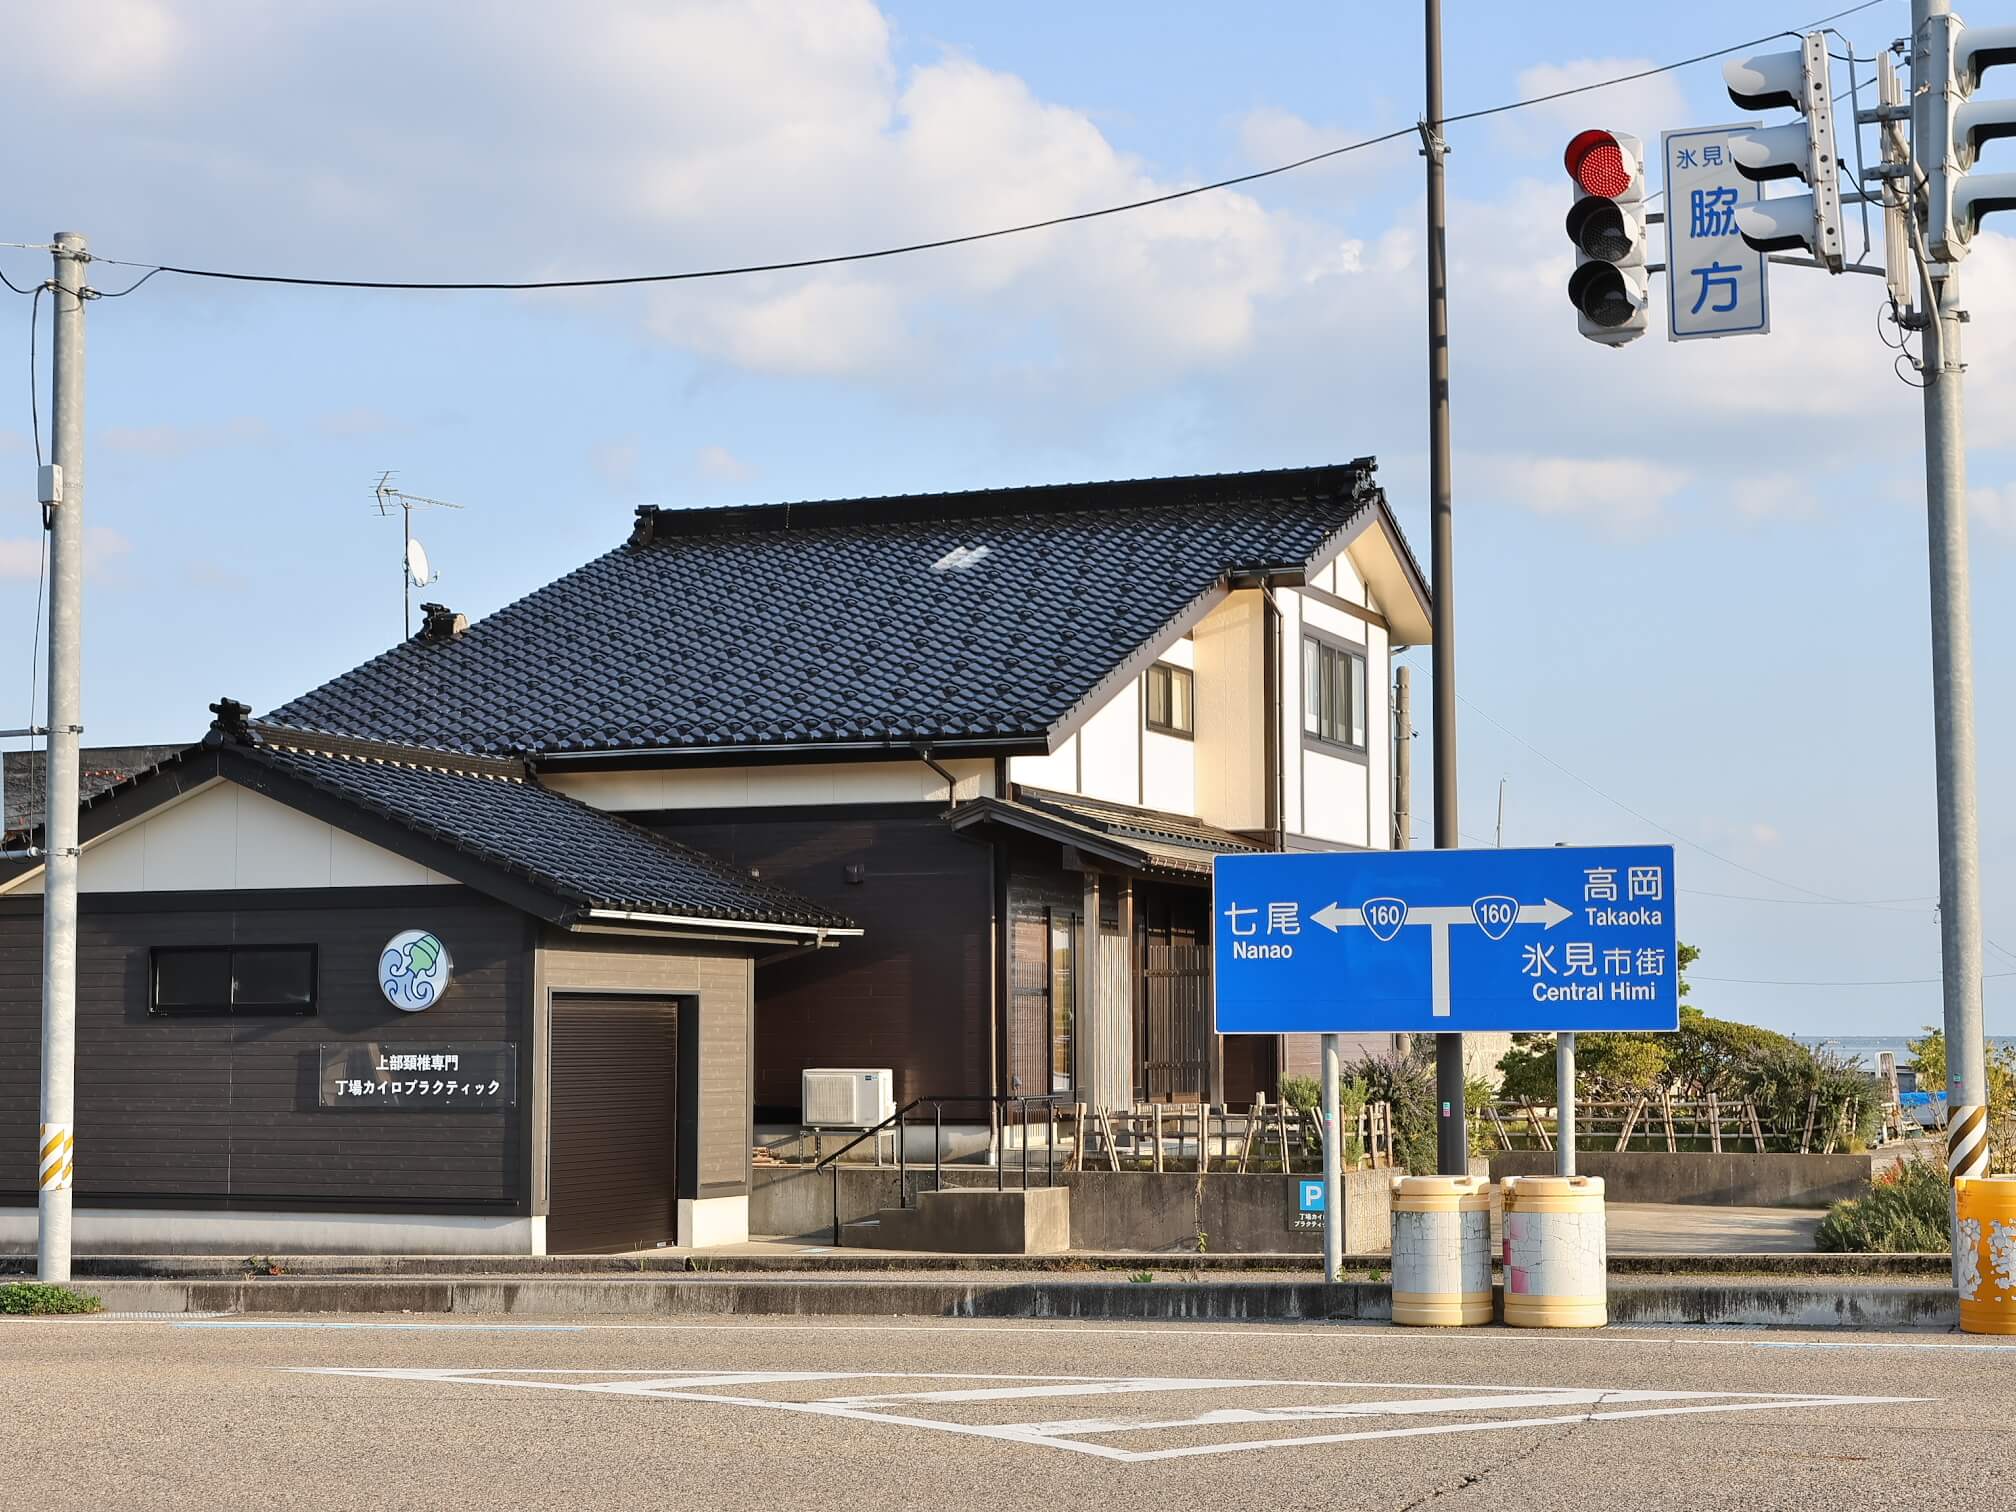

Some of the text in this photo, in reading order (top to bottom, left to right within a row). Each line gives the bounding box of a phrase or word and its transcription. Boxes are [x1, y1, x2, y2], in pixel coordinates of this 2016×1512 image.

[1676, 145, 1734, 169] 氷見
[1690, 186, 1743, 315] 脇方
[1583, 866, 1663, 902] 高岡
[1224, 902, 1300, 936] 七尾
[1369, 903, 1399, 926] 160
[1480, 902, 1511, 924] 160
[1585, 907, 1662, 926] Takaoka
[1233, 941, 1293, 960] Nanao
[1522, 942, 1665, 977] 氷見市街
[1532, 982, 1656, 1002] Central Himi
[335, 1079, 500, 1096] 丁場カイロプラクティック
[1305, 1185, 1322, 1207] P
